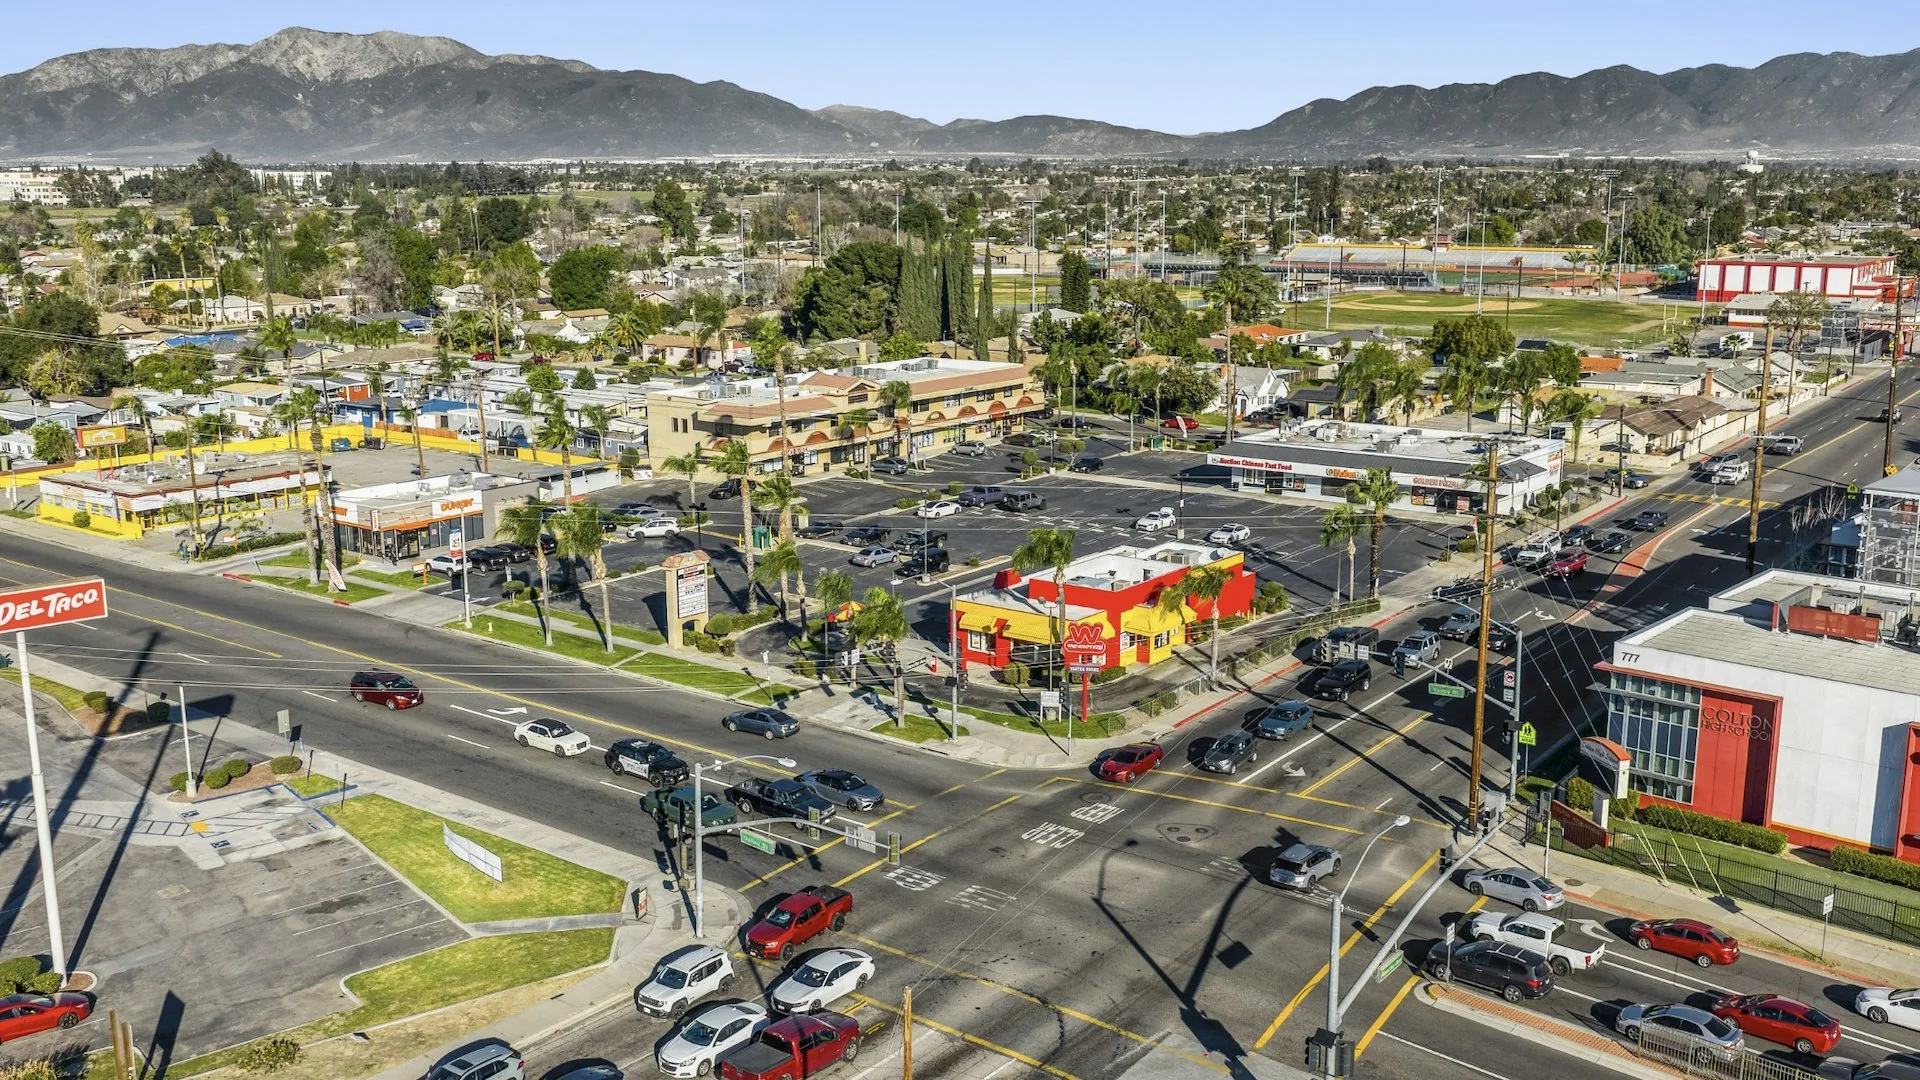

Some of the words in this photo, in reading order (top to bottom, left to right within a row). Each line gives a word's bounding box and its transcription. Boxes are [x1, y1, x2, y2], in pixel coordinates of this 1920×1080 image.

[1219, 457, 1240, 465] Auction
[1241, 459, 1264, 468] Chinese
[1278, 463, 1292, 471] Food
[0, 600, 45, 626] DEL
[41, 588, 99, 618] TACO
[1621, 651, 1640, 663] 777
[1703, 706, 1773, 730] COLTON
[1700, 720, 1726, 733] HIGH
[1728, 725, 1771, 741] SCHOOL
[1021, 821, 1085, 849] CLEAR
